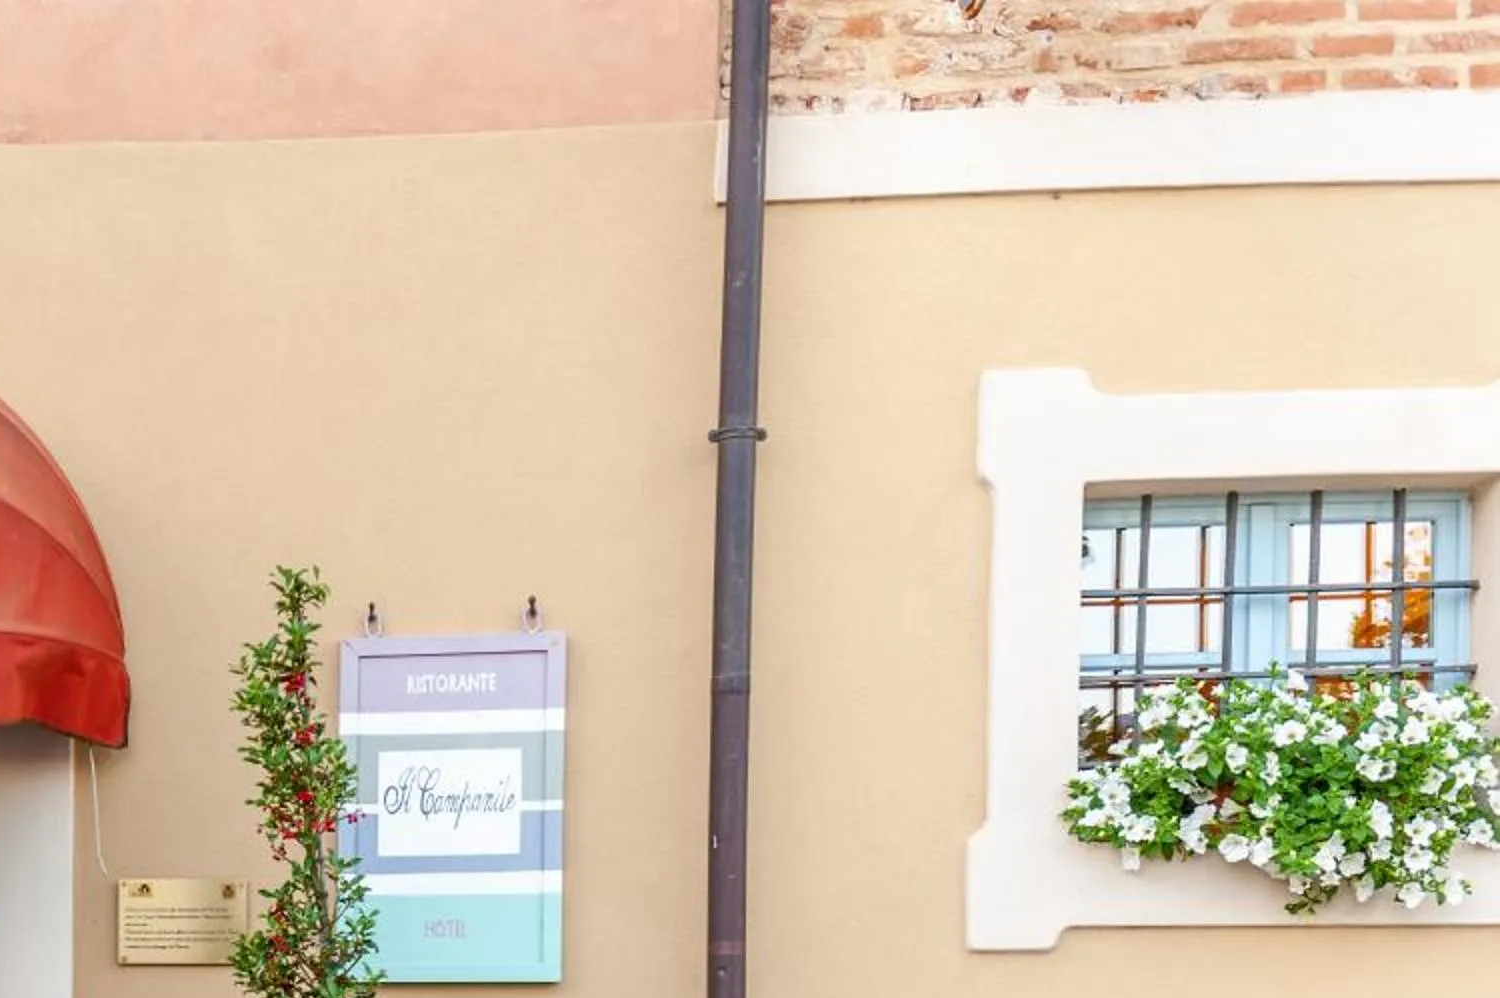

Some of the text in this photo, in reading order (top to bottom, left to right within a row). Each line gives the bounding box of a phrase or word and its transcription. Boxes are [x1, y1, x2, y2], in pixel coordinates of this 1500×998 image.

[406, 672, 498, 695] RISTORANTE
[383, 765, 516, 831] Il Campanile
[423, 918, 470, 939] HOTEL
